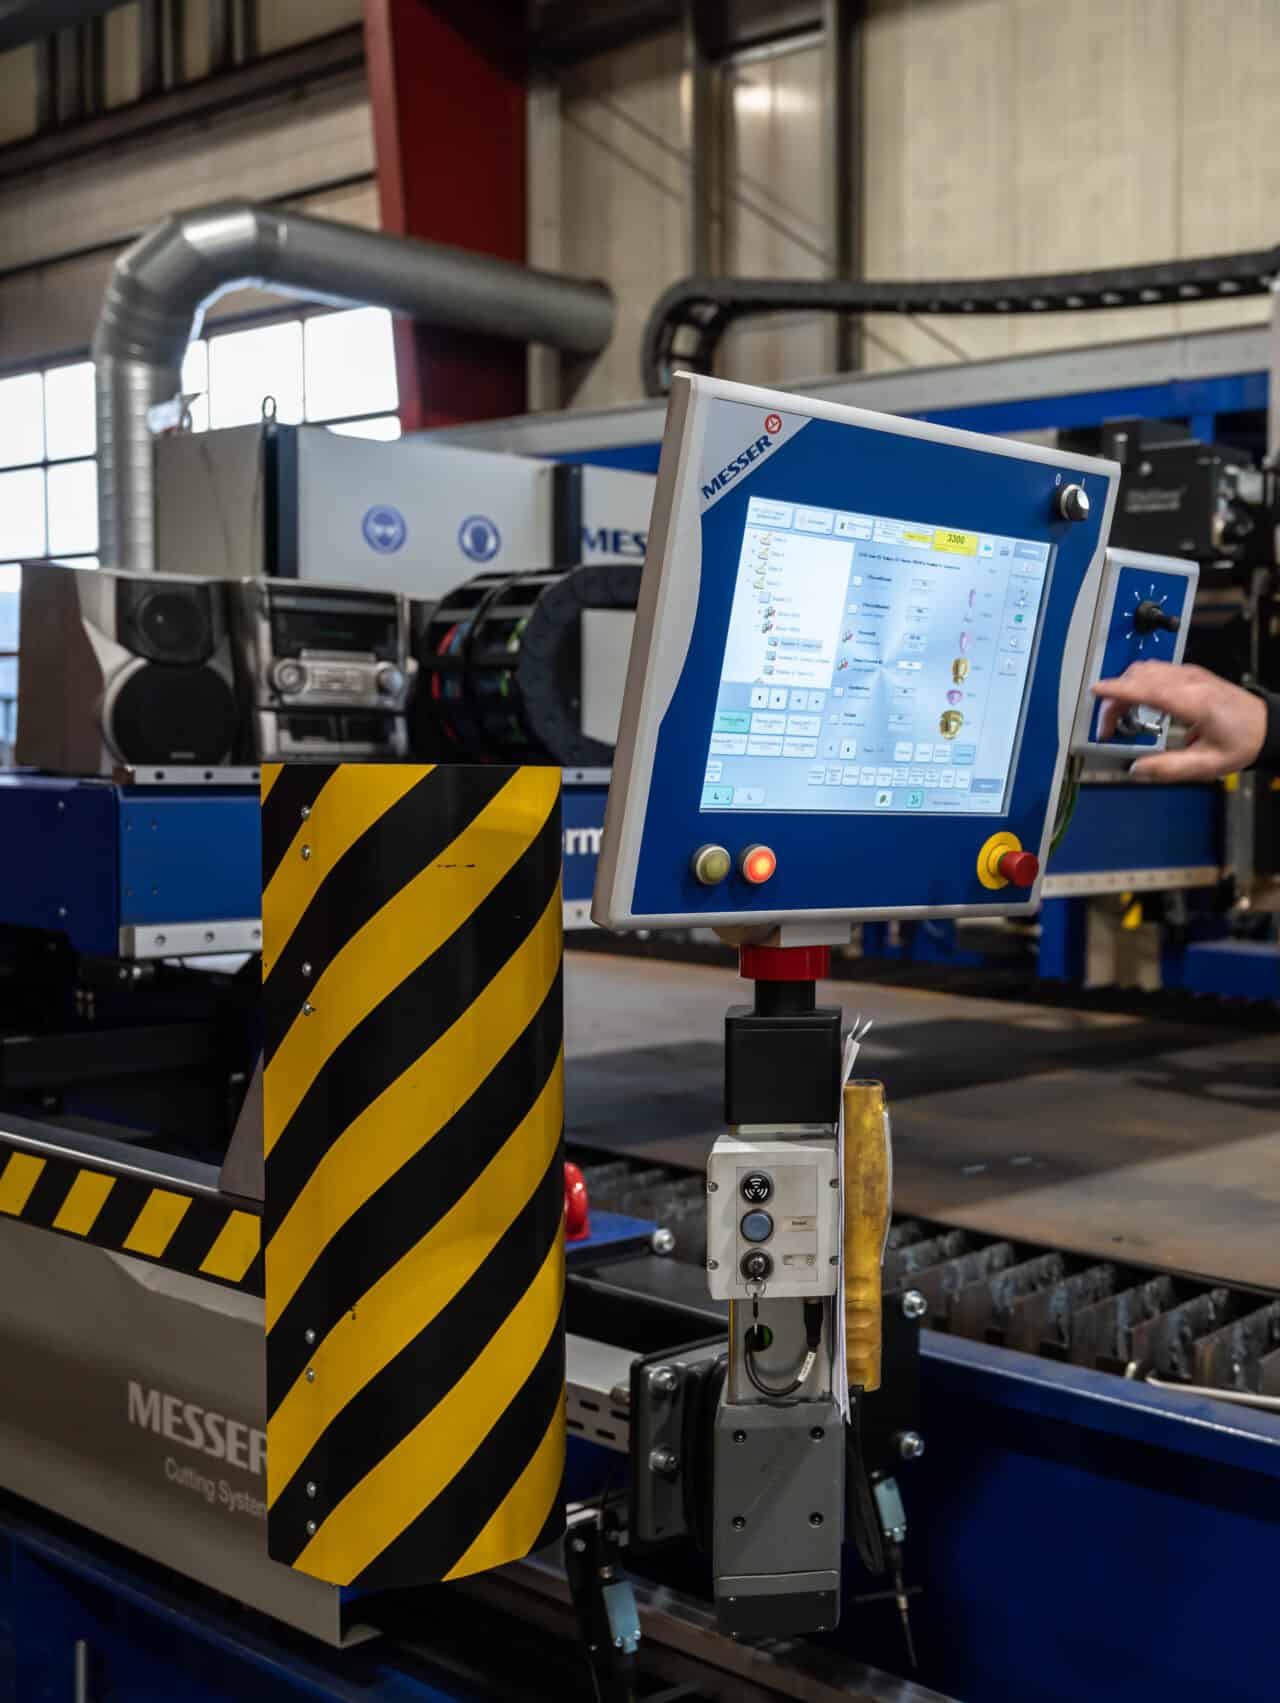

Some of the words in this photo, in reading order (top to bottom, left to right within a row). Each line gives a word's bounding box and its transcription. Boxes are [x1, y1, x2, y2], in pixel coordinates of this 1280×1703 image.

[702, 435, 773, 500] MESSER
[581, 527, 648, 557] MES
[164, 1455, 216, 1504] Cutting
